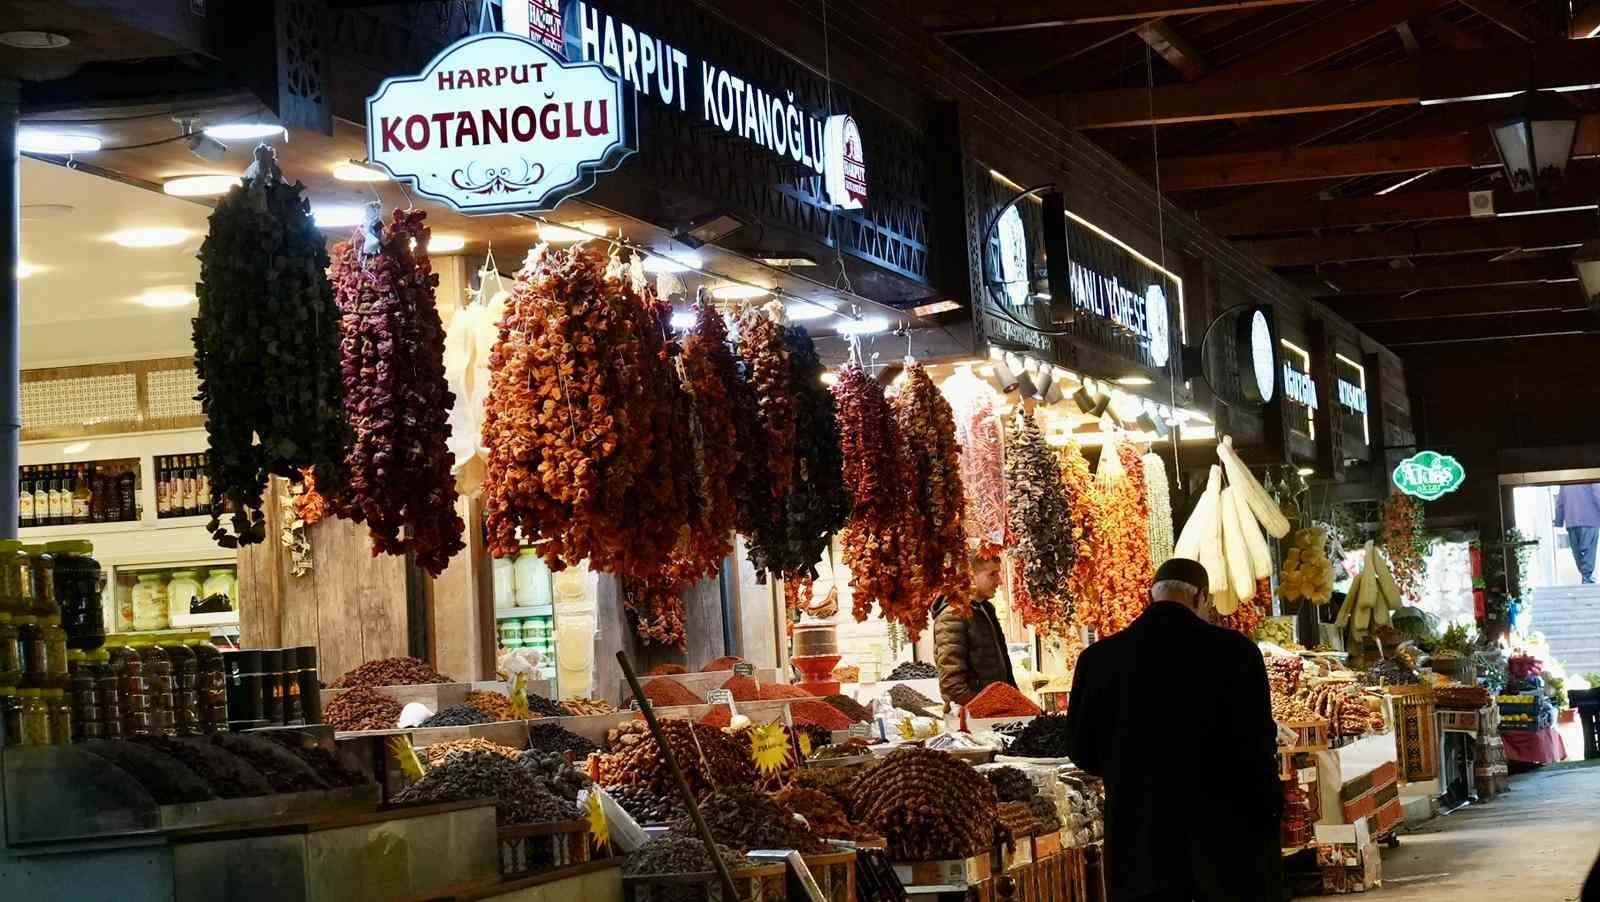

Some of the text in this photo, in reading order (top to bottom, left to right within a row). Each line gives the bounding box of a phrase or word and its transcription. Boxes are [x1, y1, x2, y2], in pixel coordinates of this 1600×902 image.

[437, 62, 548, 91] HARPUT
[579, 0, 824, 176] HARPUT KOTANOĞLU
[380, 91, 609, 153] KOTANOĞLU
